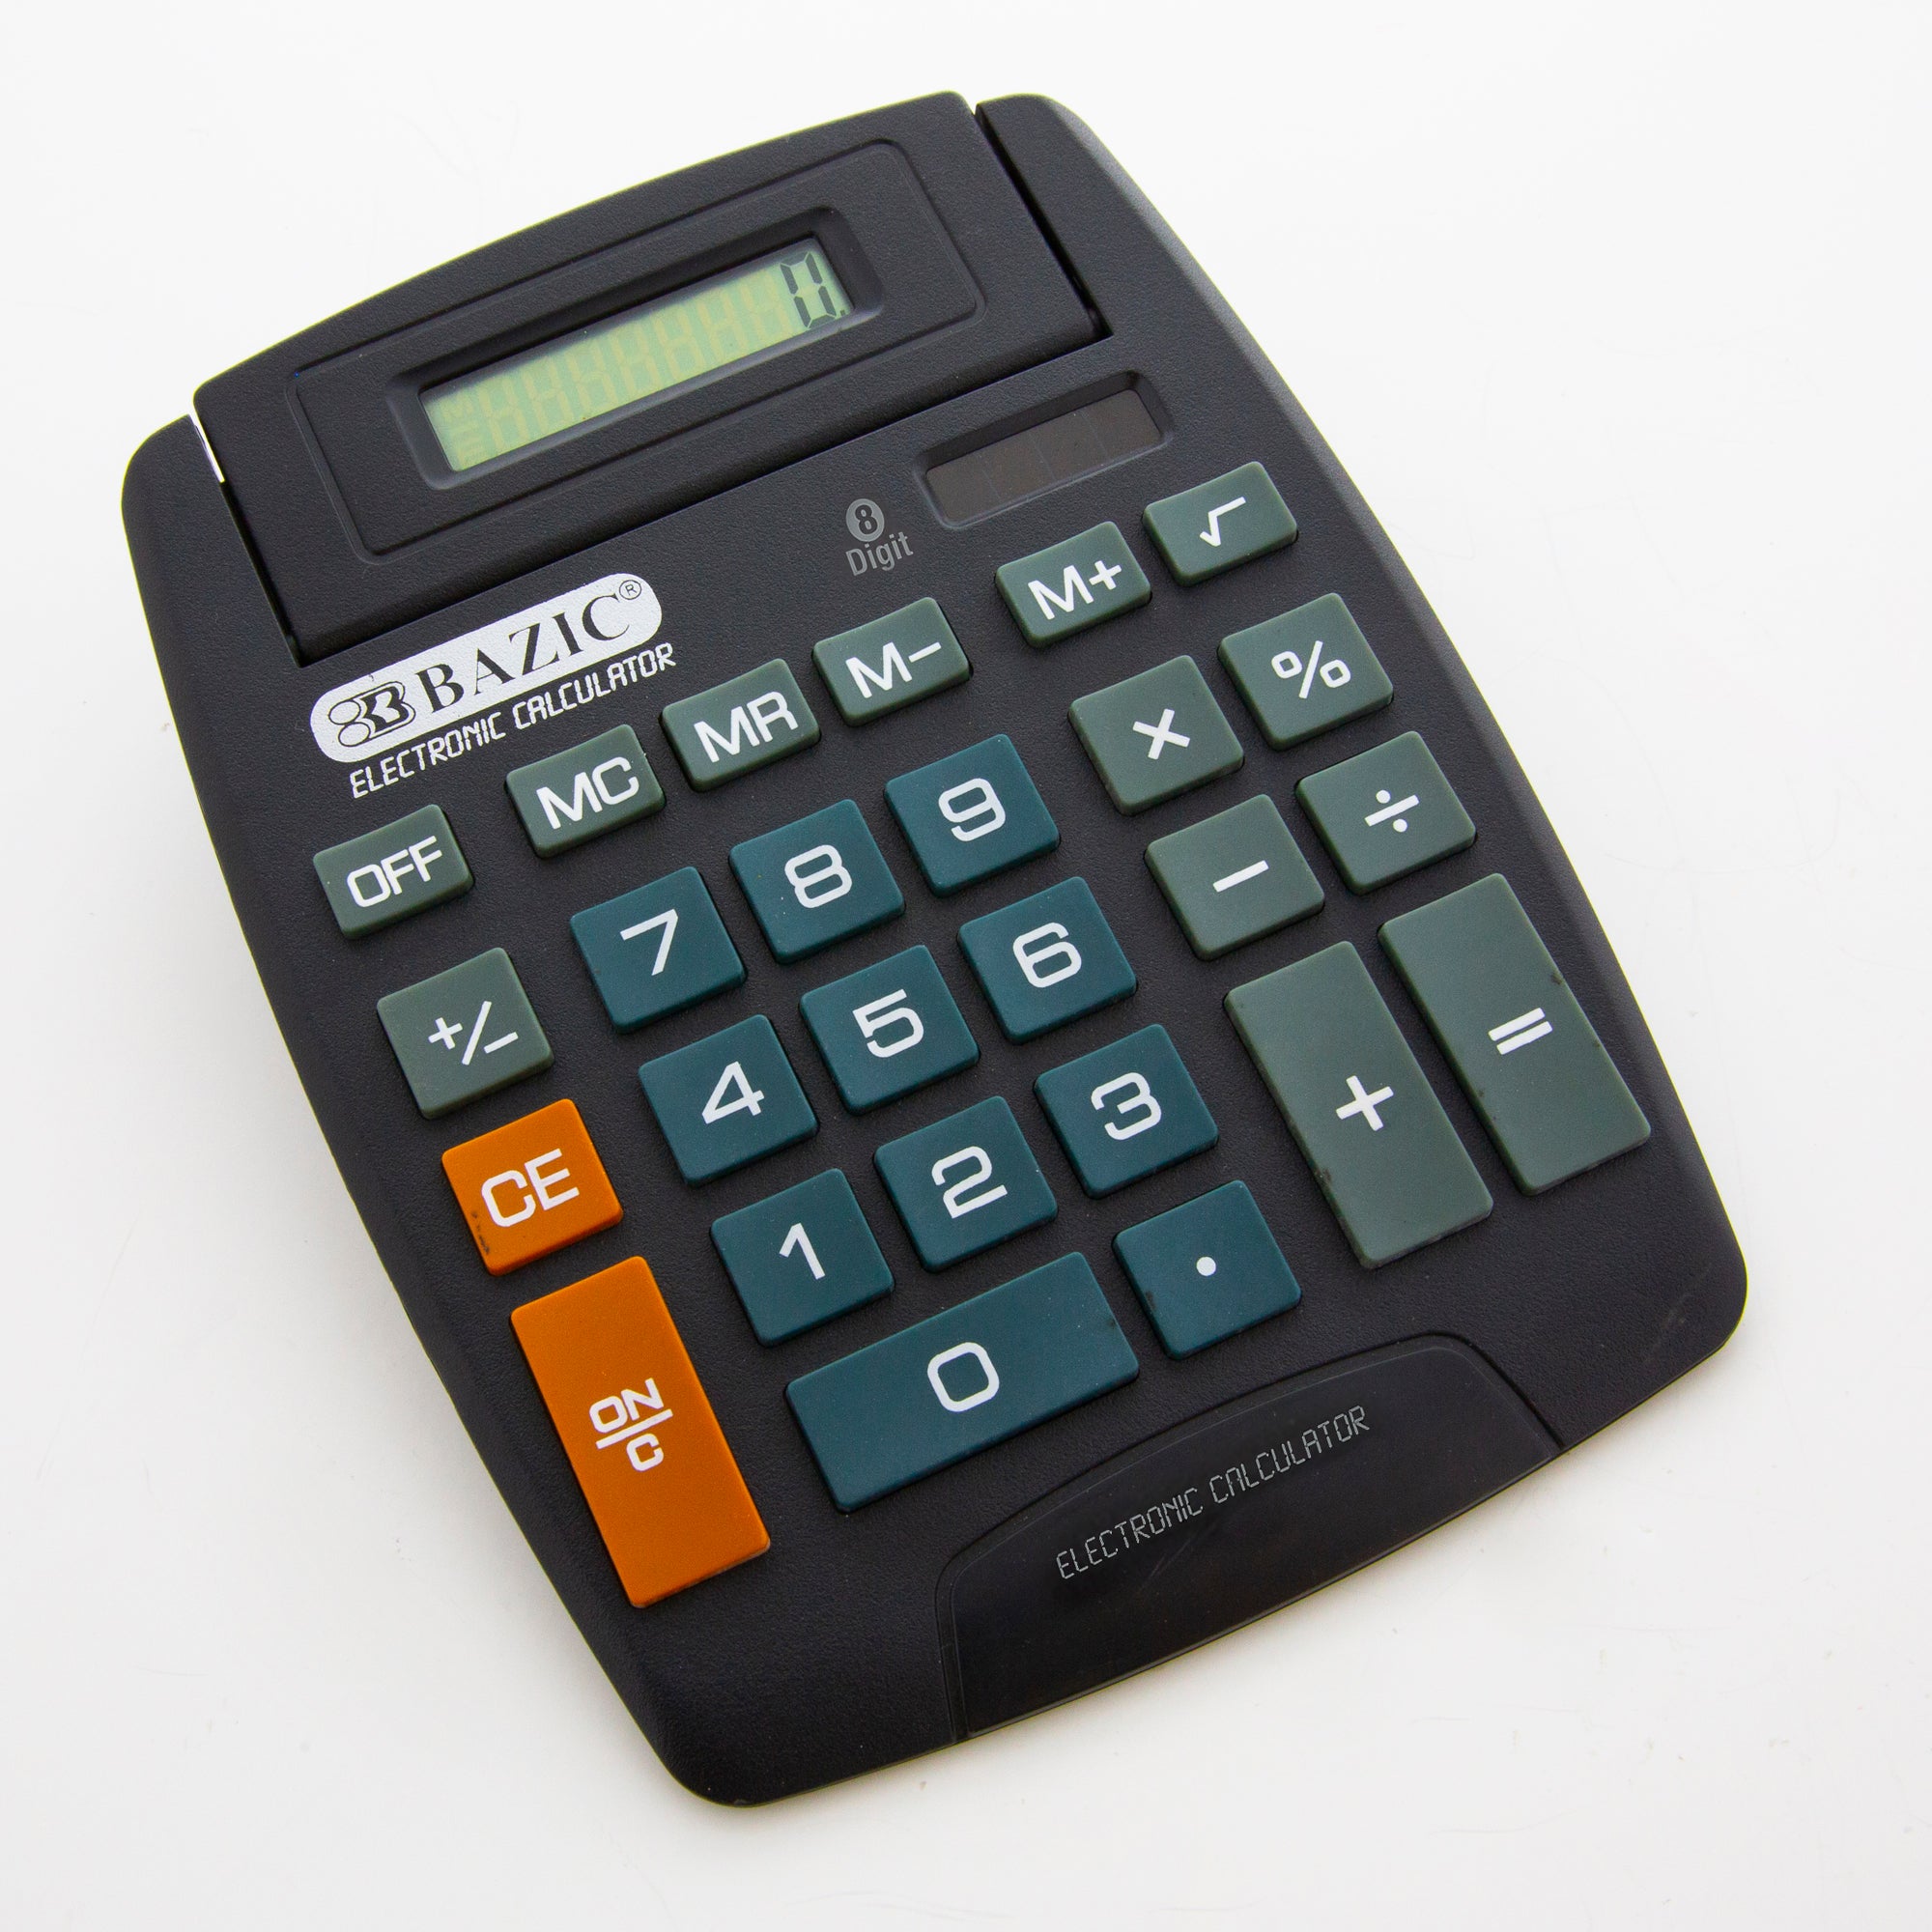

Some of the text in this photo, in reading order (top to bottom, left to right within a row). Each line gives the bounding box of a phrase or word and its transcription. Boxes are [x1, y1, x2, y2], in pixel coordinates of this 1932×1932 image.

[855, 504, 878, 535] 8
[845, 531, 914, 577] Digit
[1028, 560, 1122, 619] M+
[1271, 640, 1350, 698] %
[350, 642, 676, 799] ELECTRONIC CALCULATOR
[694, 692, 798, 762] MR
[536, 757, 639, 829] MC
[939, 779, 1006, 841] 9
[347, 836, 442, 907] OFF
[784, 845, 852, 908] 8
[620, 909, 678, 975] 7
[1013, 923, 1081, 987] 6
[853, 989, 923, 1058] 5
[702, 1062, 764, 1123] 4
[1093, 1072, 1161, 1140] 3
[481, 1150, 579, 1227] CE
[932, 1147, 1008, 1218] 2
[780, 1223, 825, 1279] 1
[589, 1379, 663, 1433] ON
[927, 1343, 999, 1411] 0
[627, 1435, 663, 1471] C
[1056, 1405, 1370, 1579] ELECTRONIC CALCULATOR
